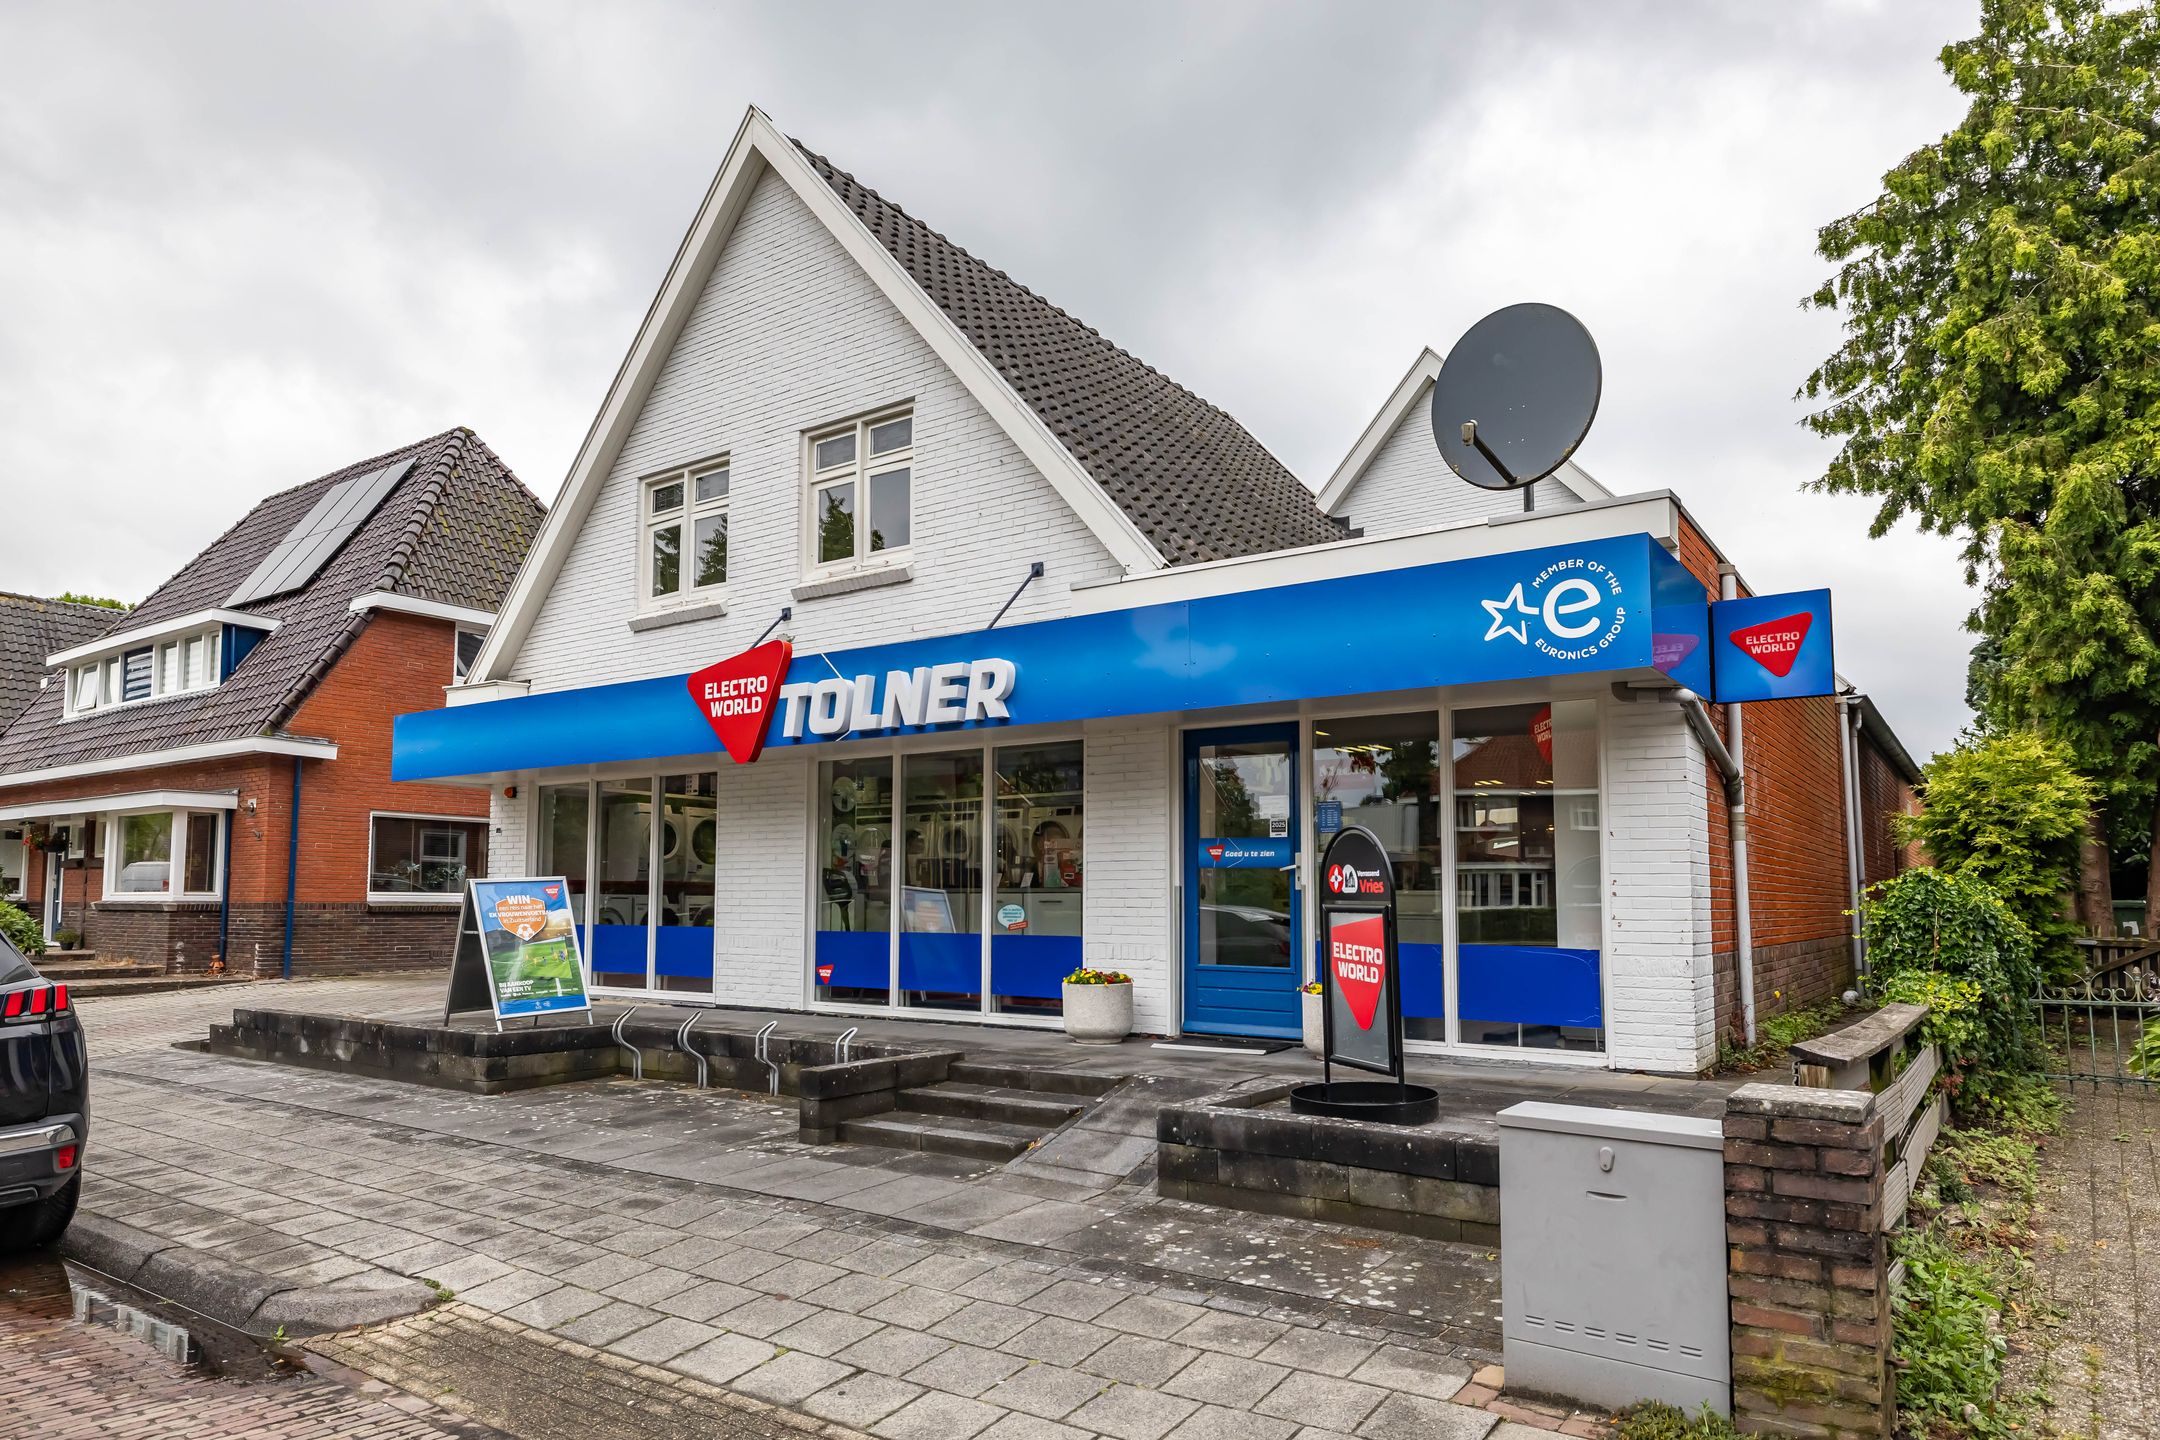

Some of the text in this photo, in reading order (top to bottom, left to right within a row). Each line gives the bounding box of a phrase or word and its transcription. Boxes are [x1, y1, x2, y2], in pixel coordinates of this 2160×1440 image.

[1532, 559, 1622, 596] MEMBER OF THE
[1535, 607, 1627, 660] EURONICS GROUP
[1745, 631, 1800, 645] ELECTRO
[1751, 641, 1796, 655] WORLD
[704, 675, 768, 700] ELECTRO
[780, 657, 1016, 738] TOLNER
[710, 696, 762, 718] WORLD
[1359, 879, 1384, 893] Vries
[506, 895, 531, 905] WIN
[1333, 942, 1383, 965] ELECTRO
[1337, 960, 1379, 983] WORLD
